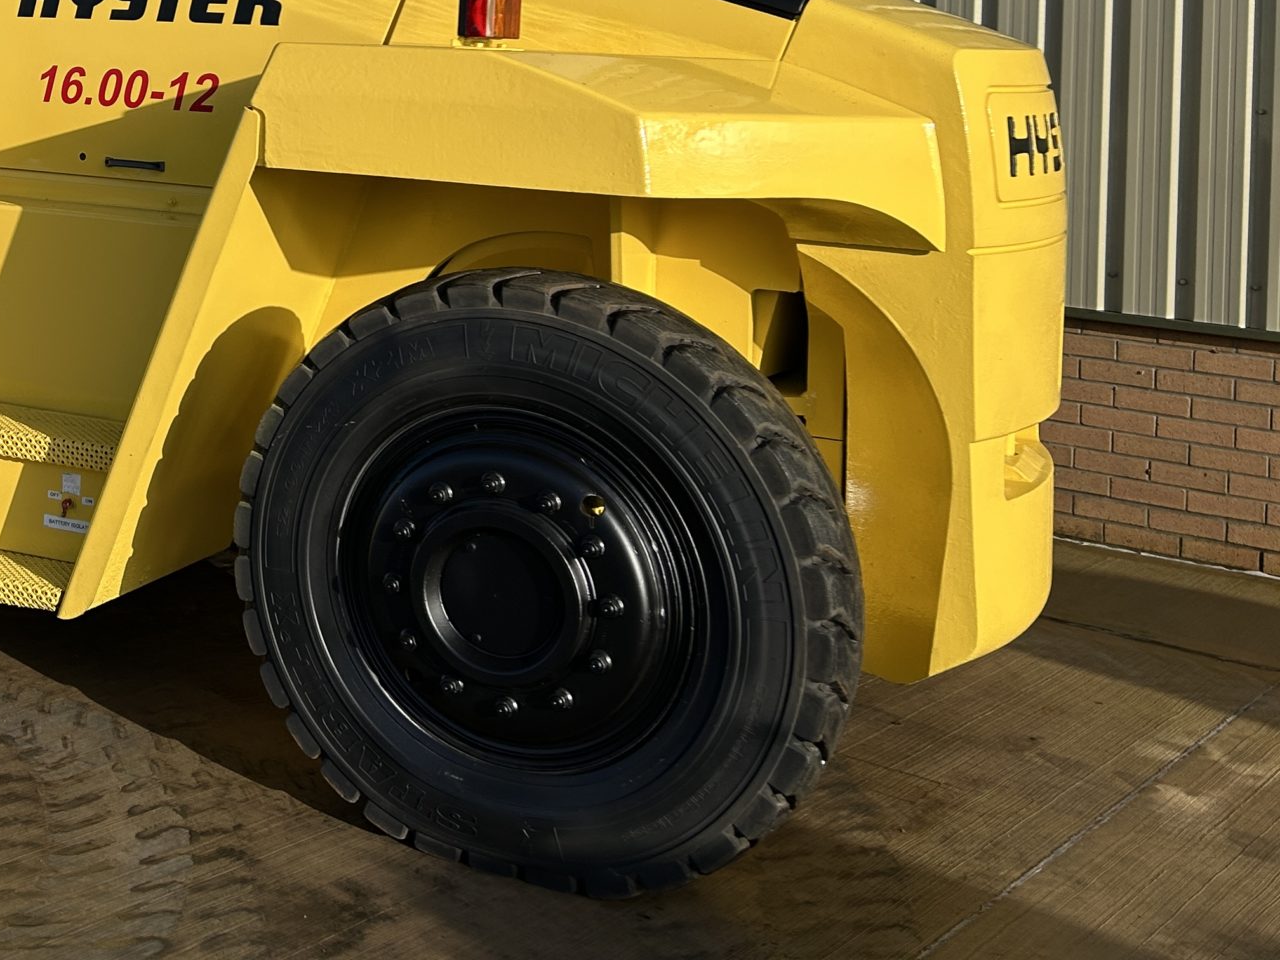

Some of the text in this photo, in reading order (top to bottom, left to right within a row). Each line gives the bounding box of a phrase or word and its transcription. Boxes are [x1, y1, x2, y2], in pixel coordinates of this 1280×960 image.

[39, 64, 220, 113] 16.00-12
[510, 325, 786, 605] MICHELIN
[48, 518, 70, 527] BATTERY
